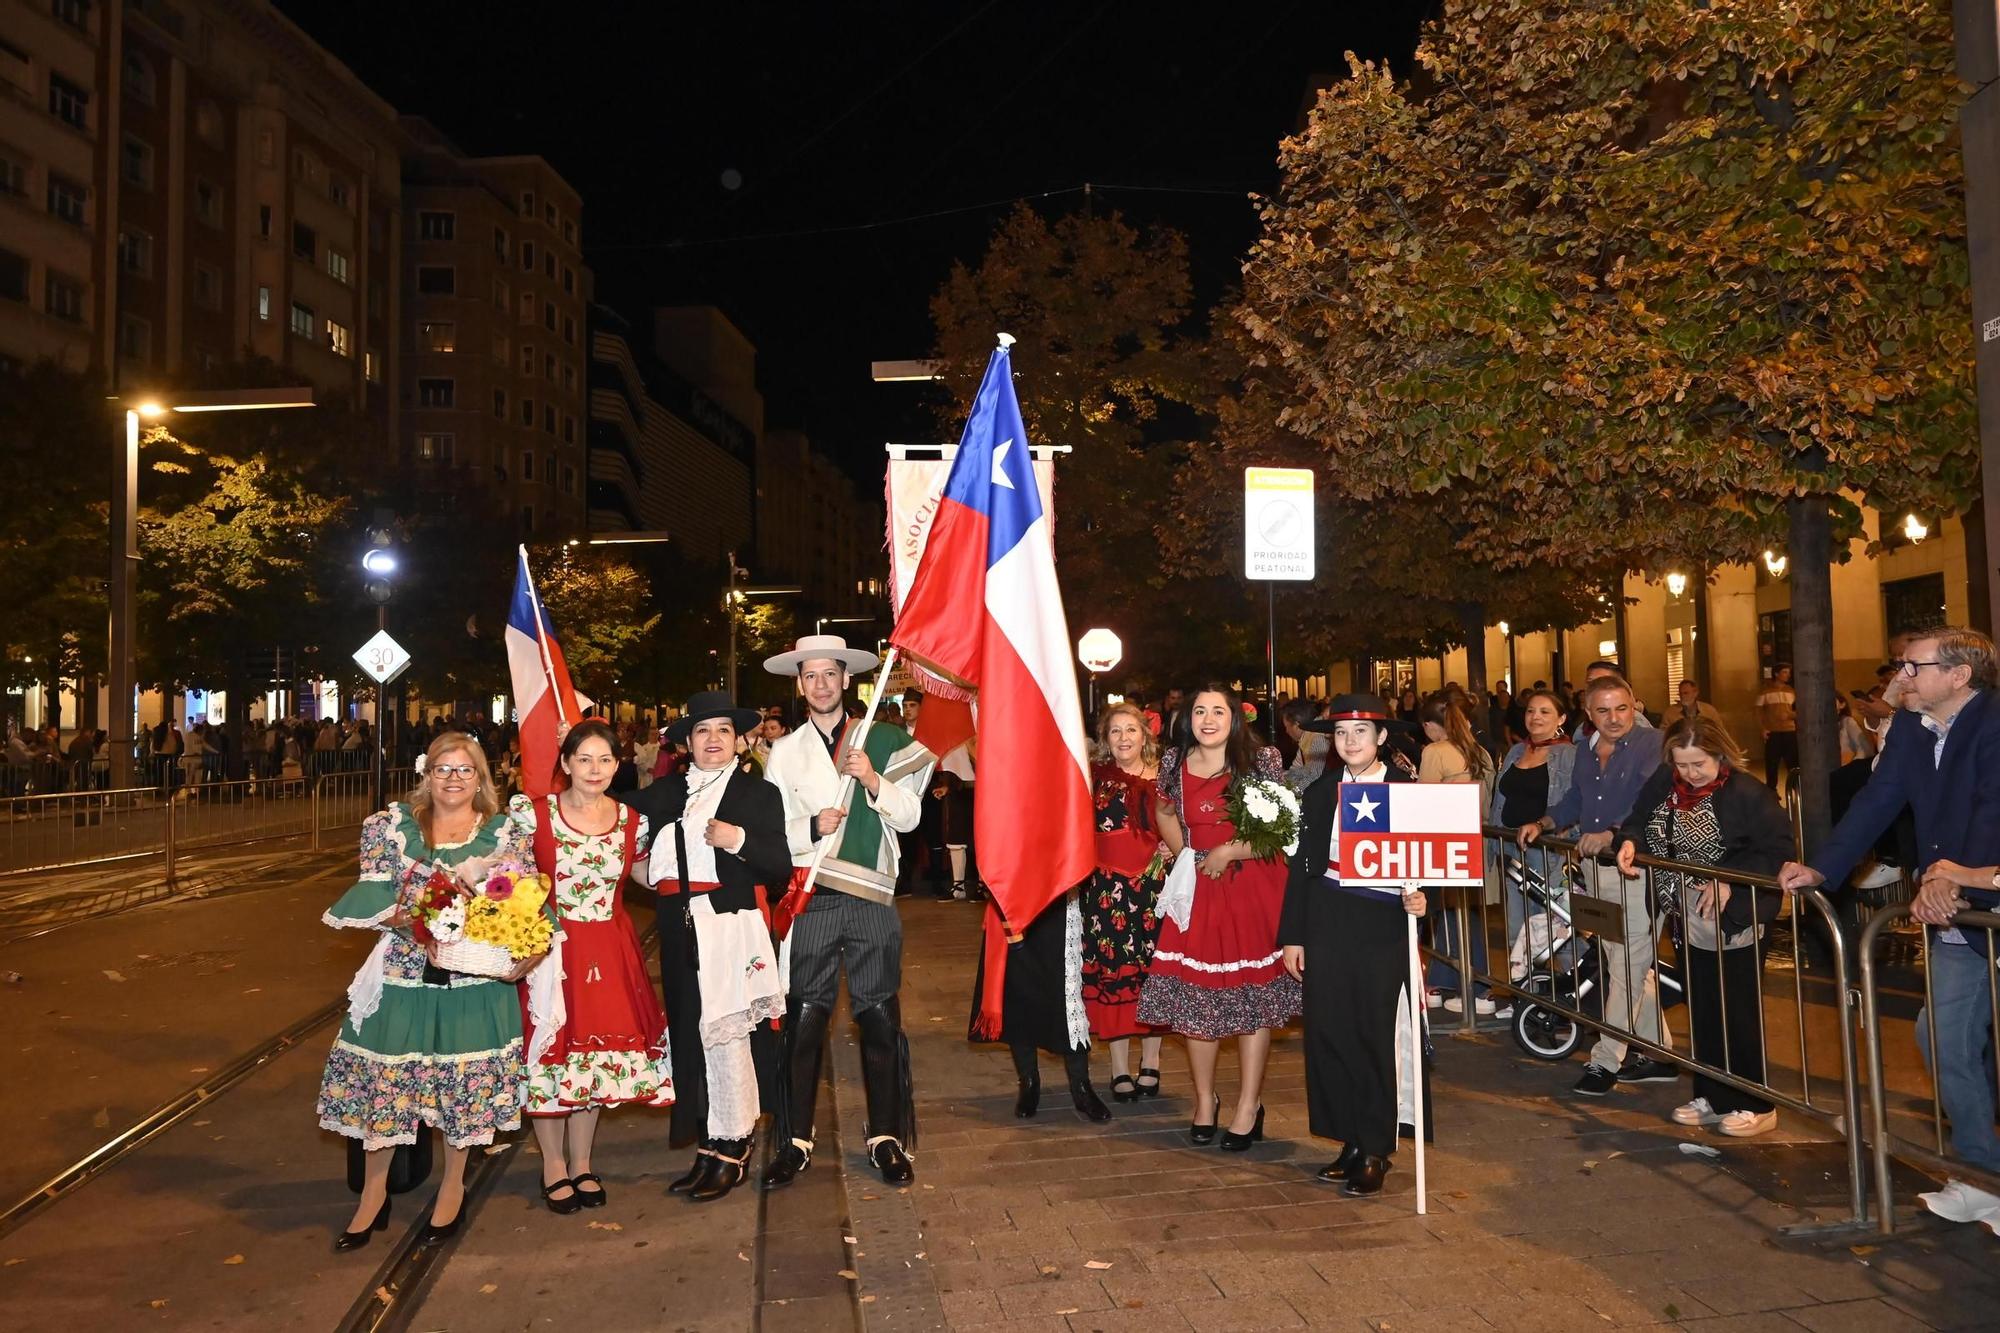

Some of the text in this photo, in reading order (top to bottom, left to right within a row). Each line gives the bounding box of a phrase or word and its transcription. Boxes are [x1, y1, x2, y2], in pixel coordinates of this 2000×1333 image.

[1253, 551, 1308, 560] PRIORIDAD
[1254, 564, 1307, 574] PEATONAL
[369, 647, 394, 665] 30
[1353, 839, 1470, 879] CHILE
